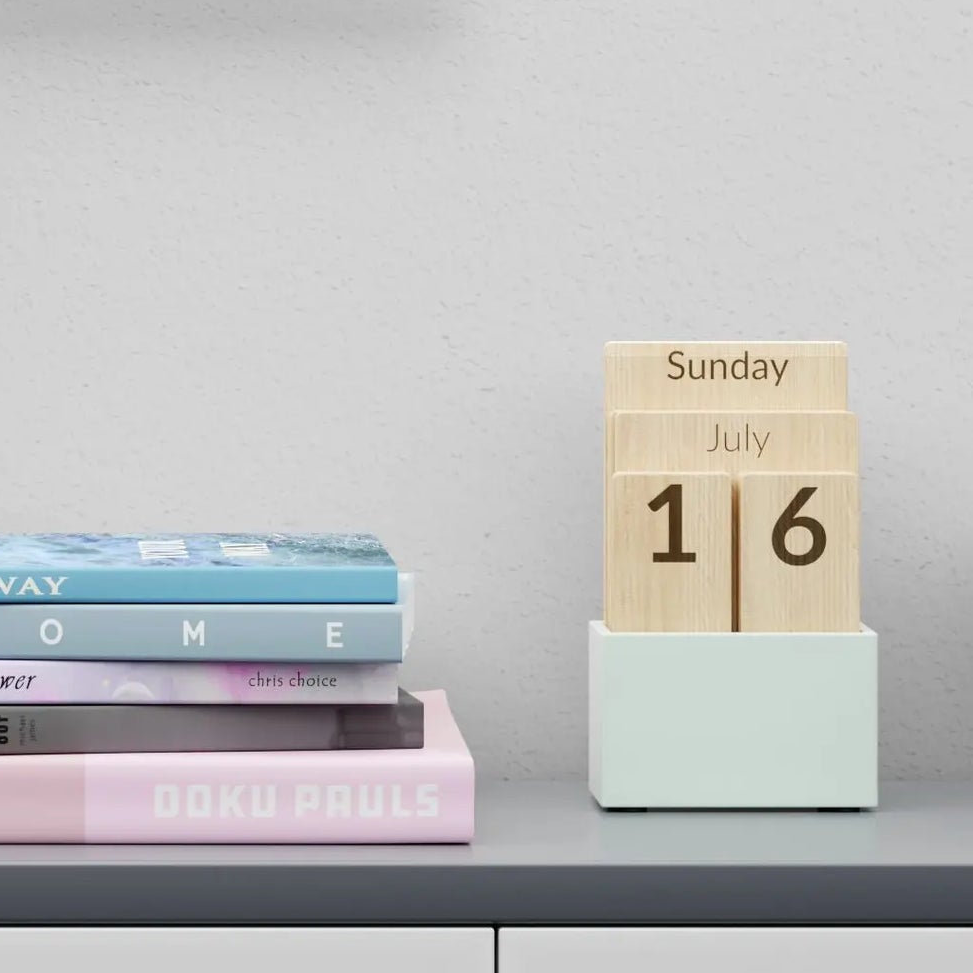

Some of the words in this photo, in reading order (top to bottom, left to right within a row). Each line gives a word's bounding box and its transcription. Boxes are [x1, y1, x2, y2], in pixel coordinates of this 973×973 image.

[667, 350, 789, 387] Sunday
[706, 423, 770, 458] July
[248, 672, 284, 688] chris
[289, 671, 338, 688] choice
[154, 784, 277, 819] DOKU
[295, 784, 439, 819] PAULS
